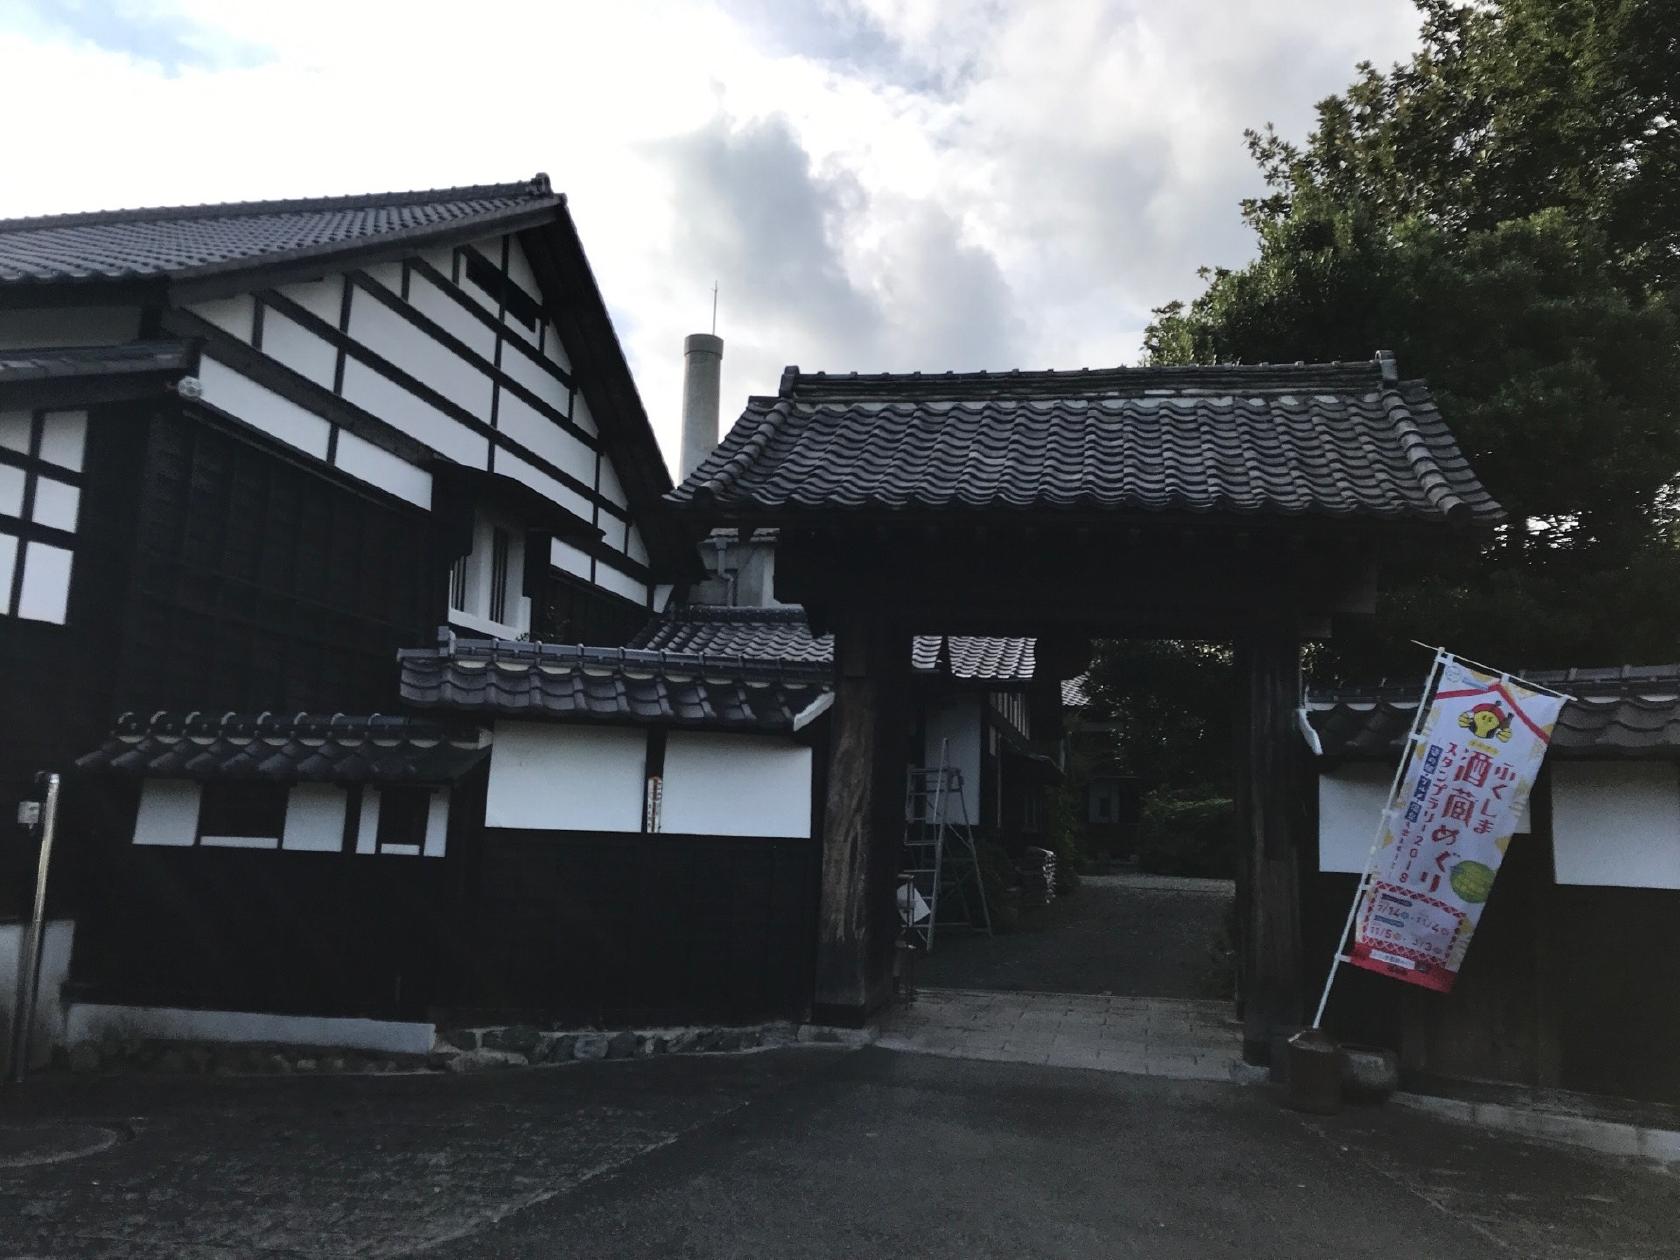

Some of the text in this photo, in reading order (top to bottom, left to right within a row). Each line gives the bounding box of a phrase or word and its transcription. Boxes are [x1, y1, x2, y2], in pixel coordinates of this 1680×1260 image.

[1420, 748, 1494, 892] 酒蔵めぐり
[1473, 762, 1516, 834] ふくしま
